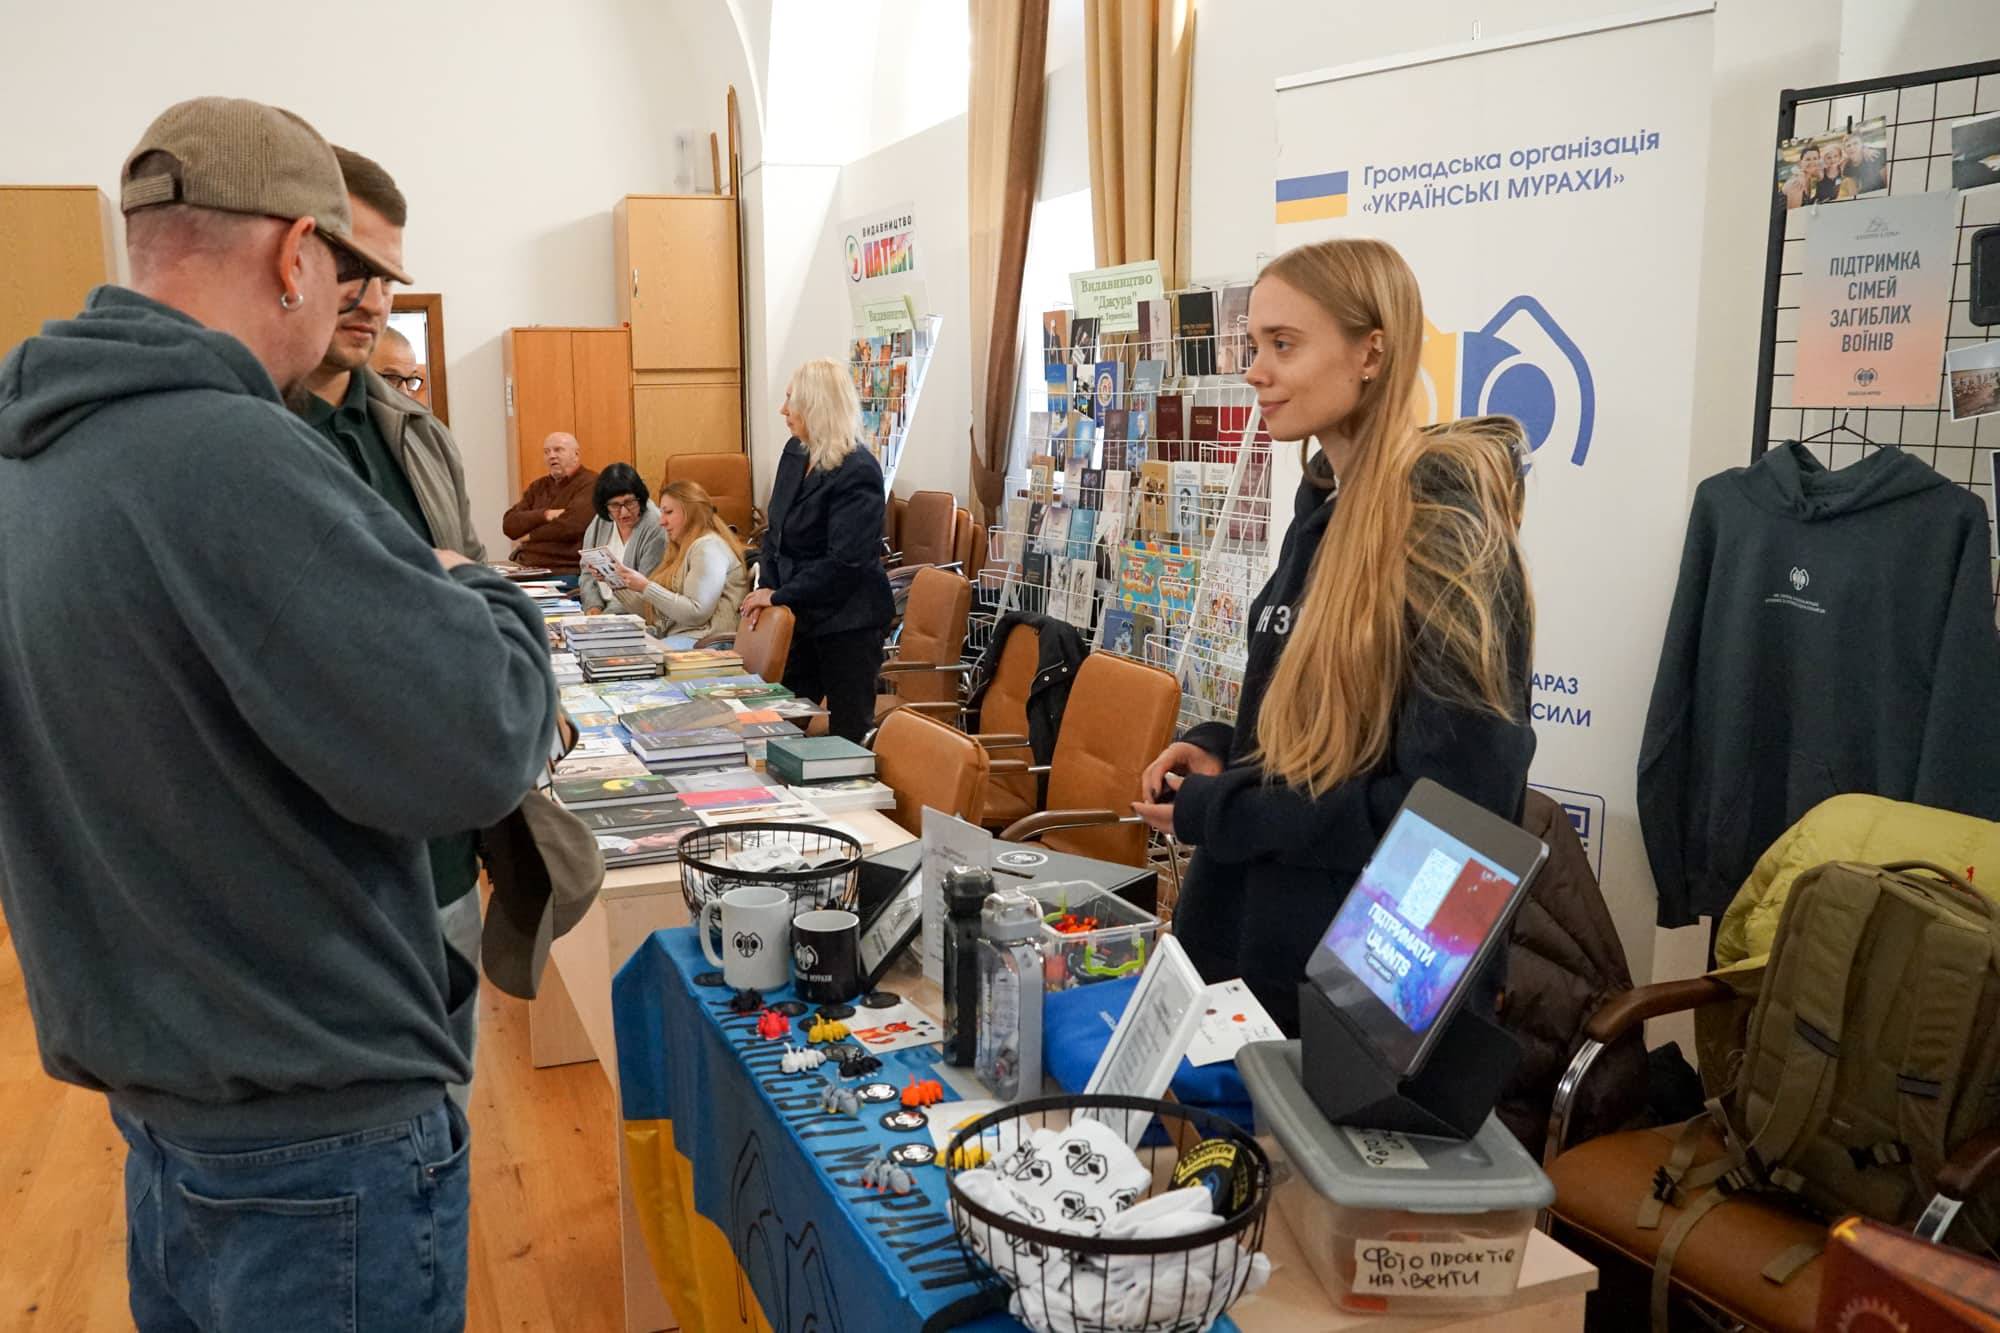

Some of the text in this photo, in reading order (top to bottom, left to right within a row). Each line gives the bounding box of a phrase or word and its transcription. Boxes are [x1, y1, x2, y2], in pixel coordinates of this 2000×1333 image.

[1363, 129, 1660, 187] Громадська організація
[1362, 166, 1625, 214] «УКРАЇНСЬКІ МУРАХИ»
[862, 215, 912, 238] ВИДАВНИЦТВО
[1829, 250, 1921, 277] ПІДТРИМКА
[1081, 273, 1153, 293] Видавництво
[1848, 275, 1897, 300] СІМЕЙ
[1830, 304, 1911, 328] ЗАГИБЛИХ
[1841, 330, 1893, 353] ВОЇНІВ
